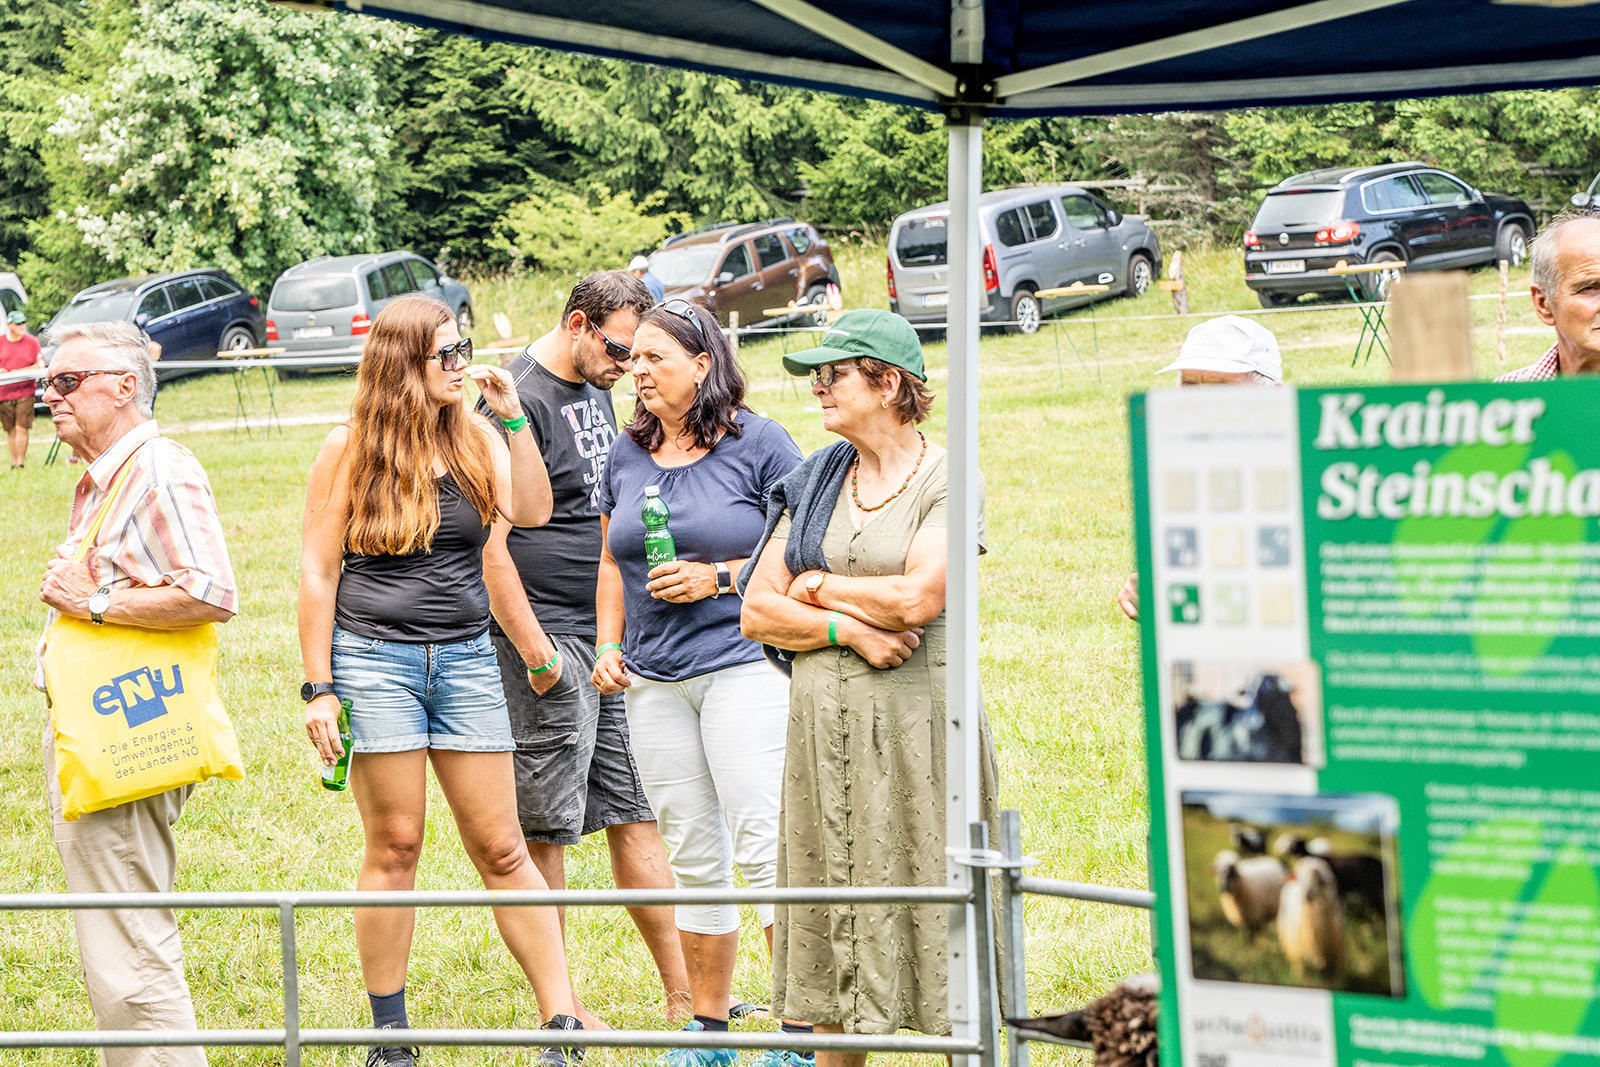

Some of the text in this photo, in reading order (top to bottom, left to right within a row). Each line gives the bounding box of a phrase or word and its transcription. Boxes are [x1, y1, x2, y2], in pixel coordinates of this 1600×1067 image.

[1312, 388, 1547, 450] Krainer
[1316, 456, 1600, 521] Steinscha
[109, 721, 193, 755] Die Energie- &
[112, 735, 195, 767] Umweltagentur
[115, 744, 199, 779] des Landes NÖ
